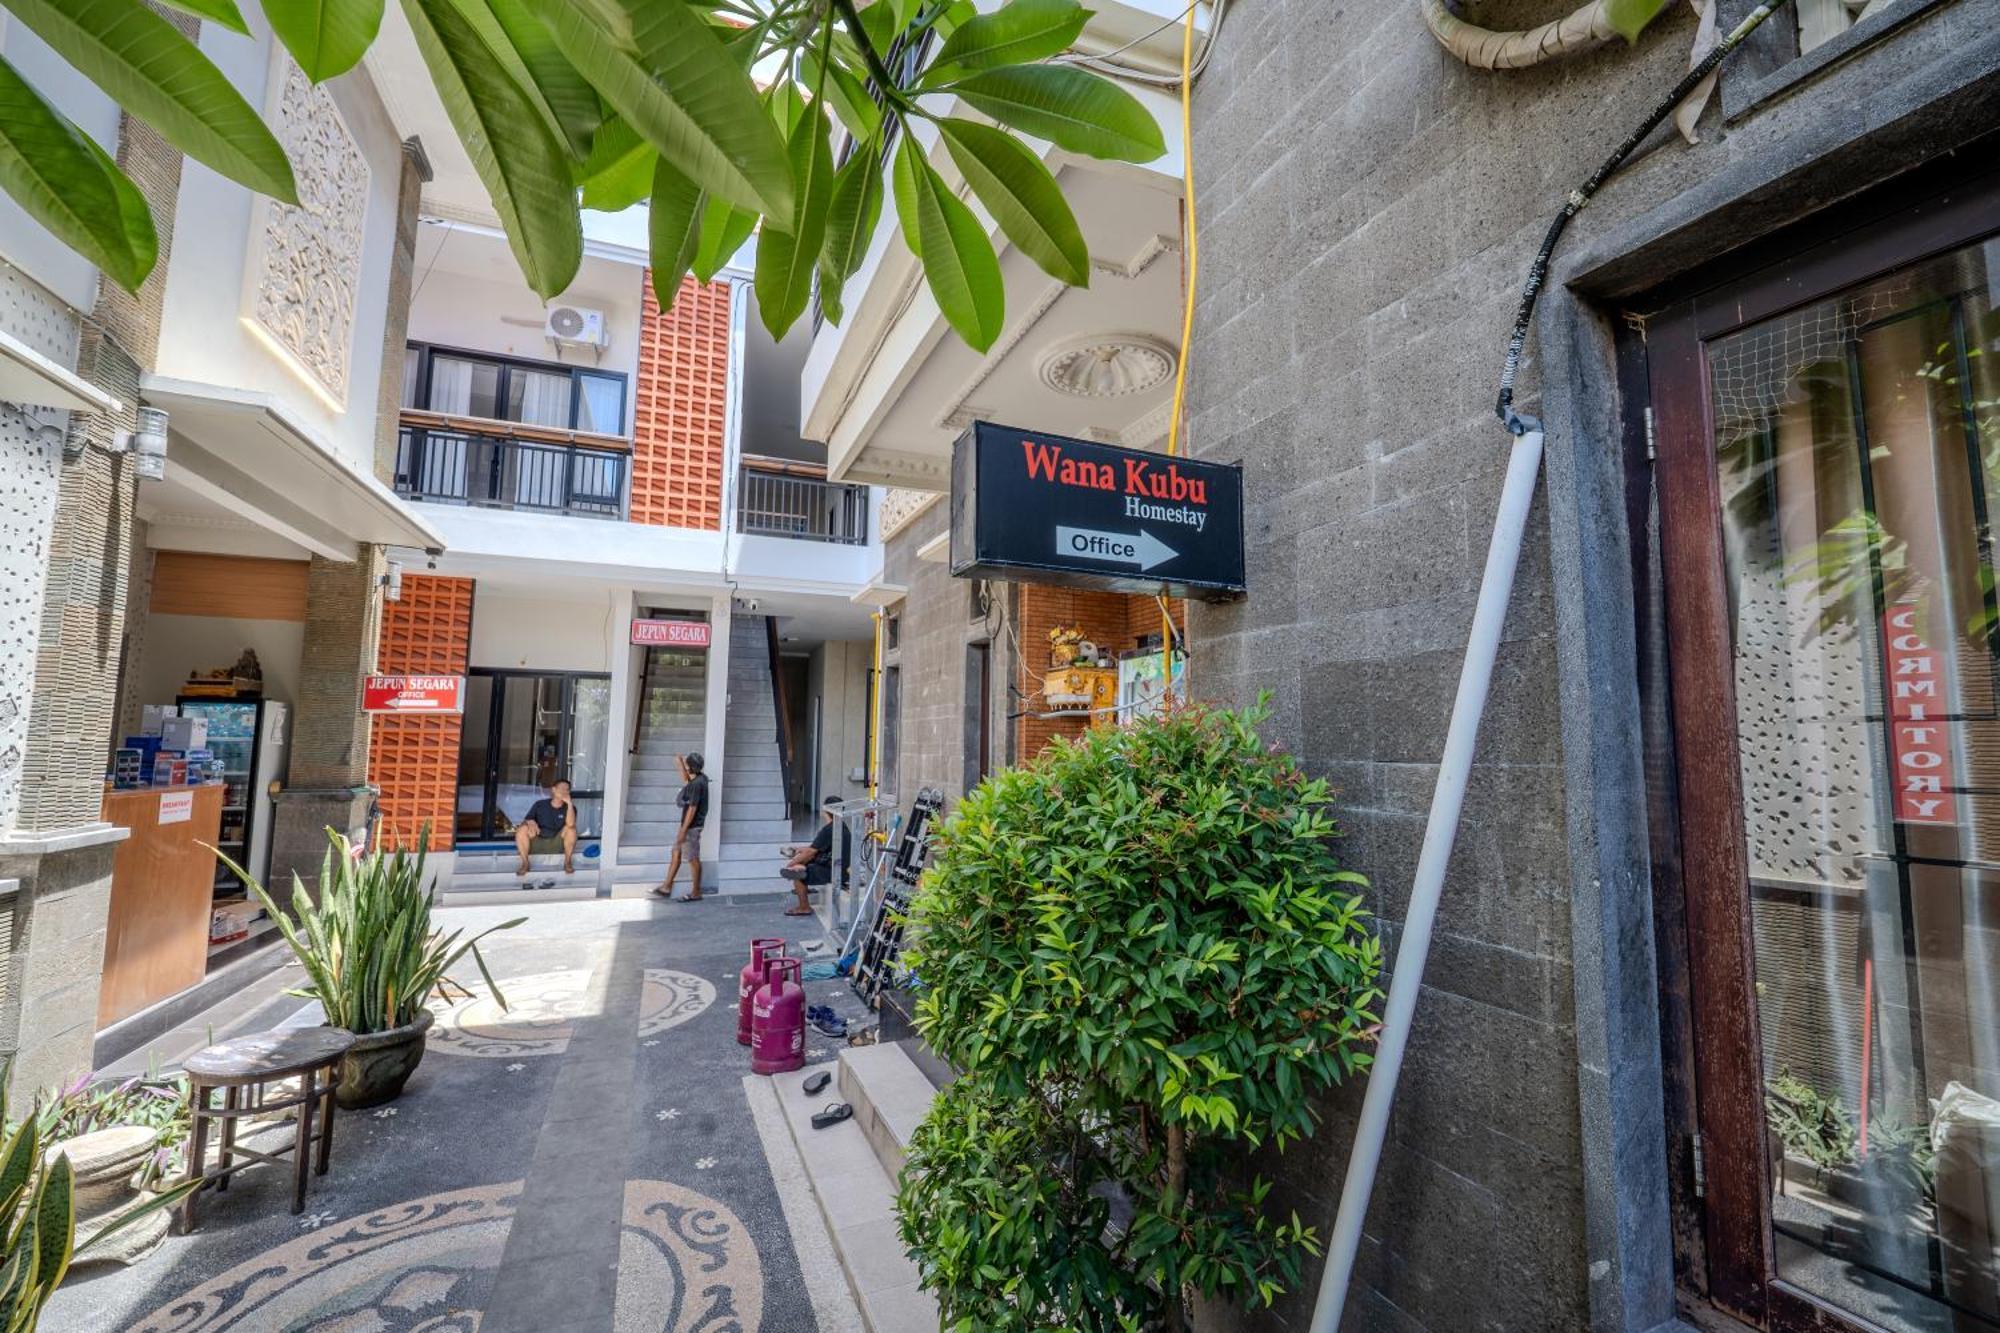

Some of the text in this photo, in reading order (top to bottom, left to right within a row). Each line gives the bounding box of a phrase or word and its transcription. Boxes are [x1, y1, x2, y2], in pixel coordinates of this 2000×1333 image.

[1022, 441, 1207, 503] Wana Kubu
[1125, 496, 1207, 531] Homestay
[1071, 534, 1135, 557] Office
[635, 624, 706, 641] JEPUN SEGARA
[369, 678, 454, 690] JEPUN SEGARA
